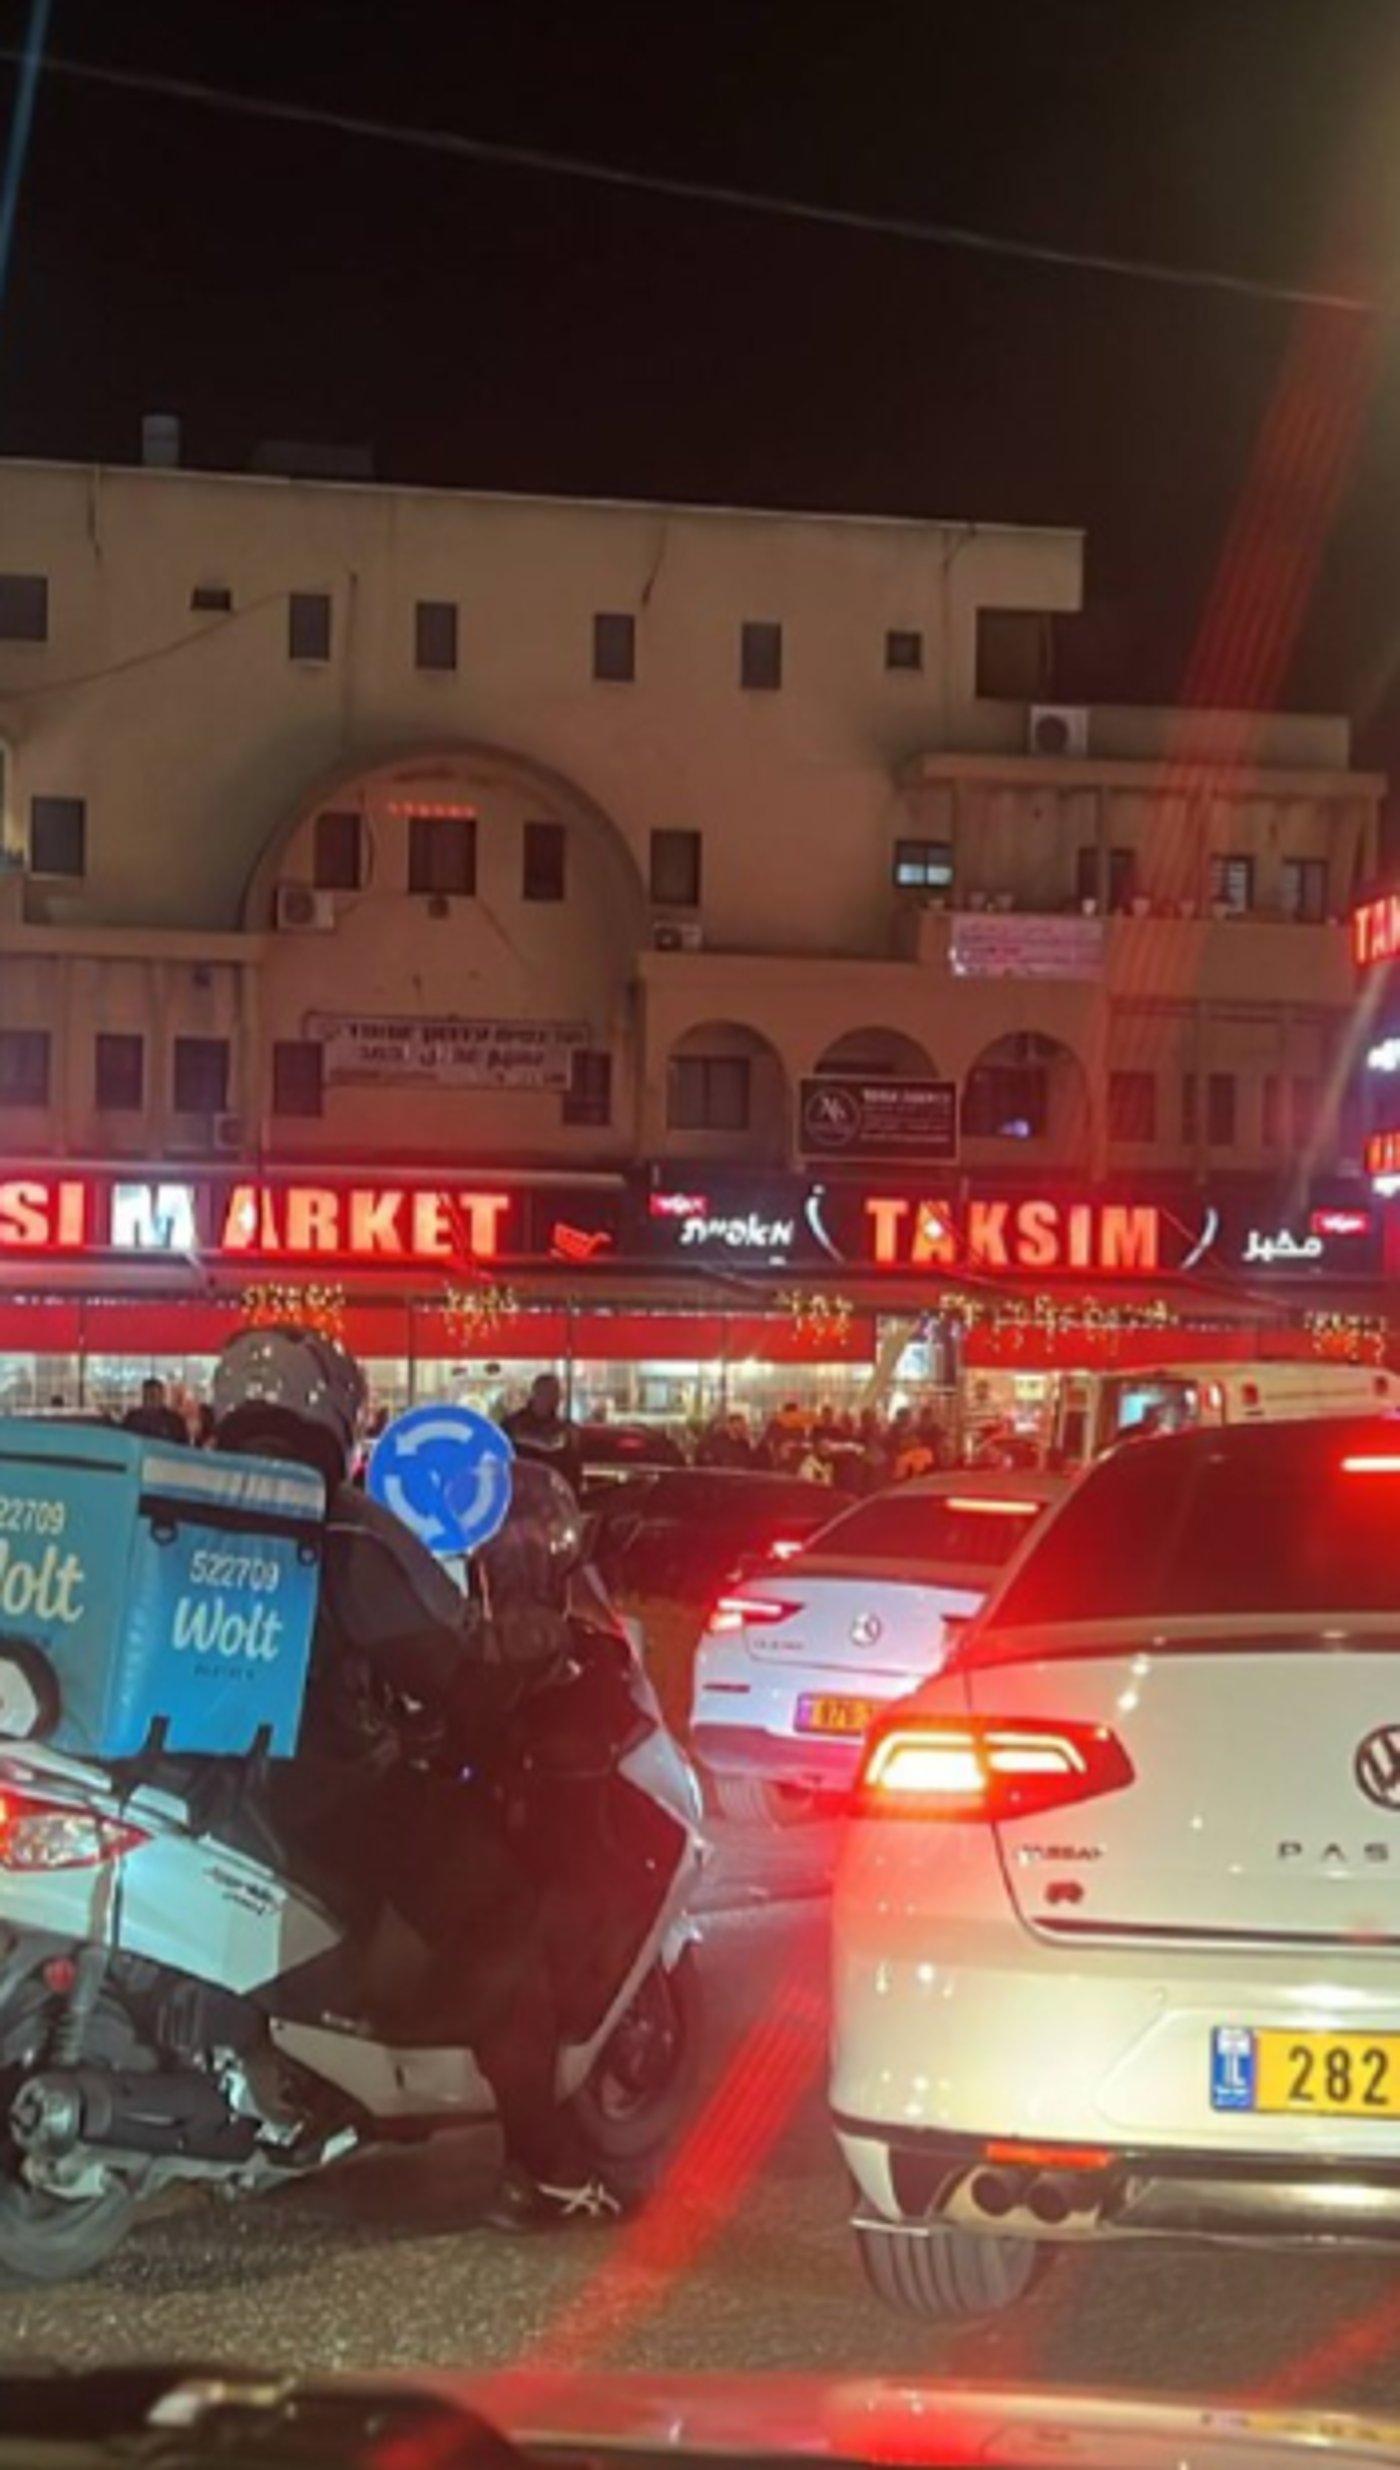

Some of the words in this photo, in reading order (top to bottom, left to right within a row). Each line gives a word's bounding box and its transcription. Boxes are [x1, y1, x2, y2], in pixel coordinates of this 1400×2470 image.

[866, 1198, 1159, 1268] TAKSIM
[0, 1537, 86, 1623] olt
[189, 1550, 280, 1593] 522709
[172, 1597, 284, 1662] Wolt
[1277, 1841, 1391, 1862] PAS
[1287, 2044, 1390, 2107] 282
